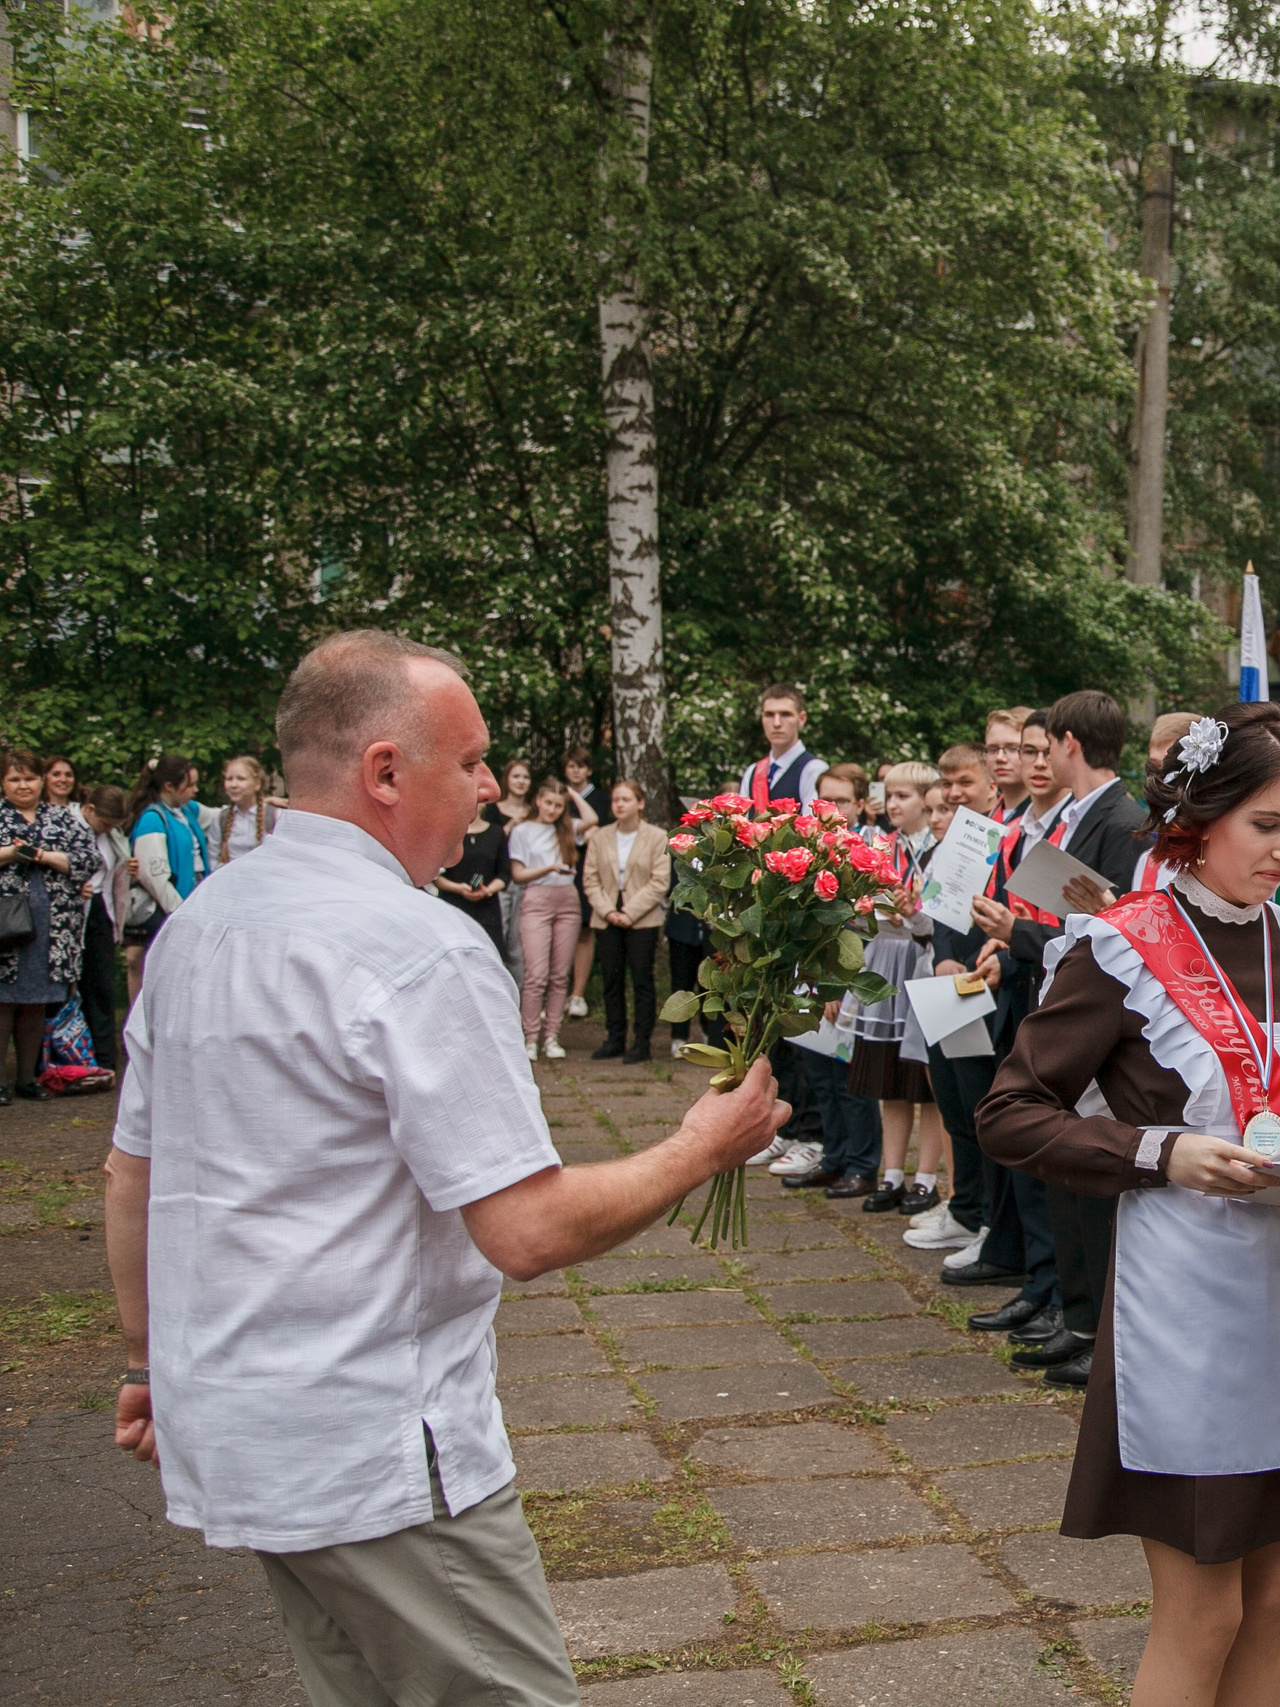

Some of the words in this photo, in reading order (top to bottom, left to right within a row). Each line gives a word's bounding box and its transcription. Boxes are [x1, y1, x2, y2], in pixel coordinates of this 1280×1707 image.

[963, 832, 987, 848] ГРАМОТА
[1165, 979, 1185, 993] 11
[1179, 998, 1209, 1030] класс
[1231, 1075, 1244, 1101] МОУ
